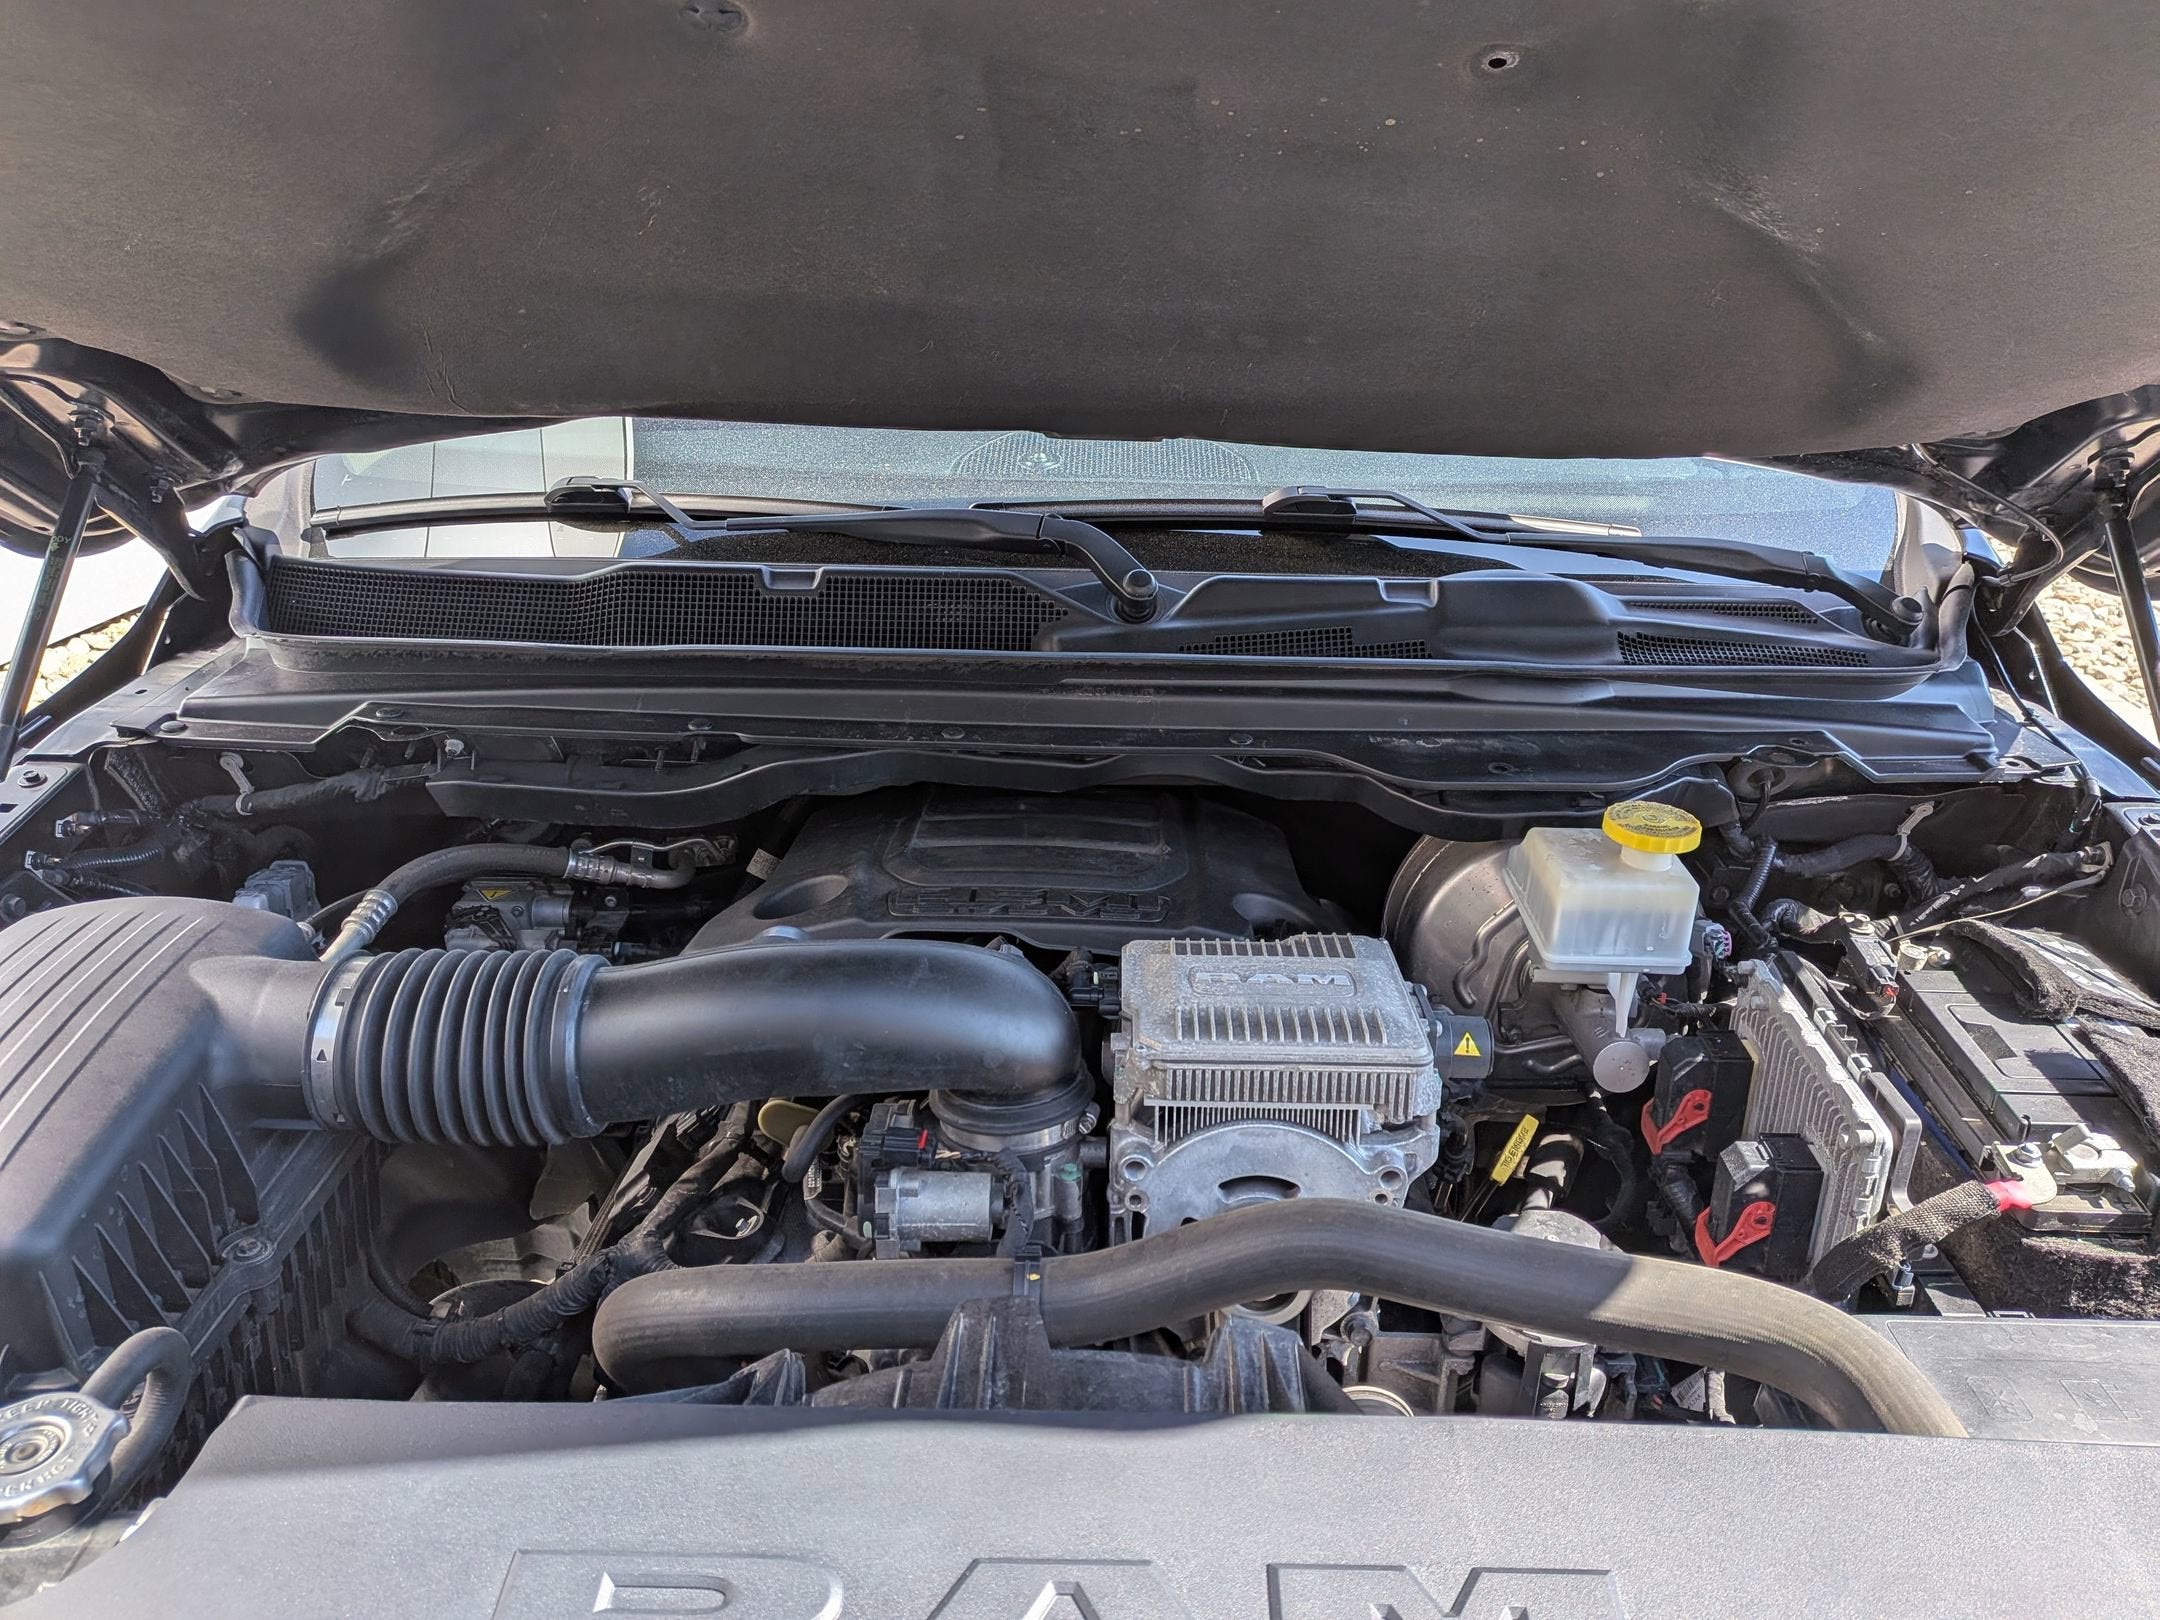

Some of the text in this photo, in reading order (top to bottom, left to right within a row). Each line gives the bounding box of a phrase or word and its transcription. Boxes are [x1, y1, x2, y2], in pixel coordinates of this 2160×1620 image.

[1195, 972, 1351, 986] RAM
[1509, 1126, 1530, 1158] ENGINE
[0, 1398, 99, 1424] EEP TIGHT
[37, 1454, 75, 1484] HOT
